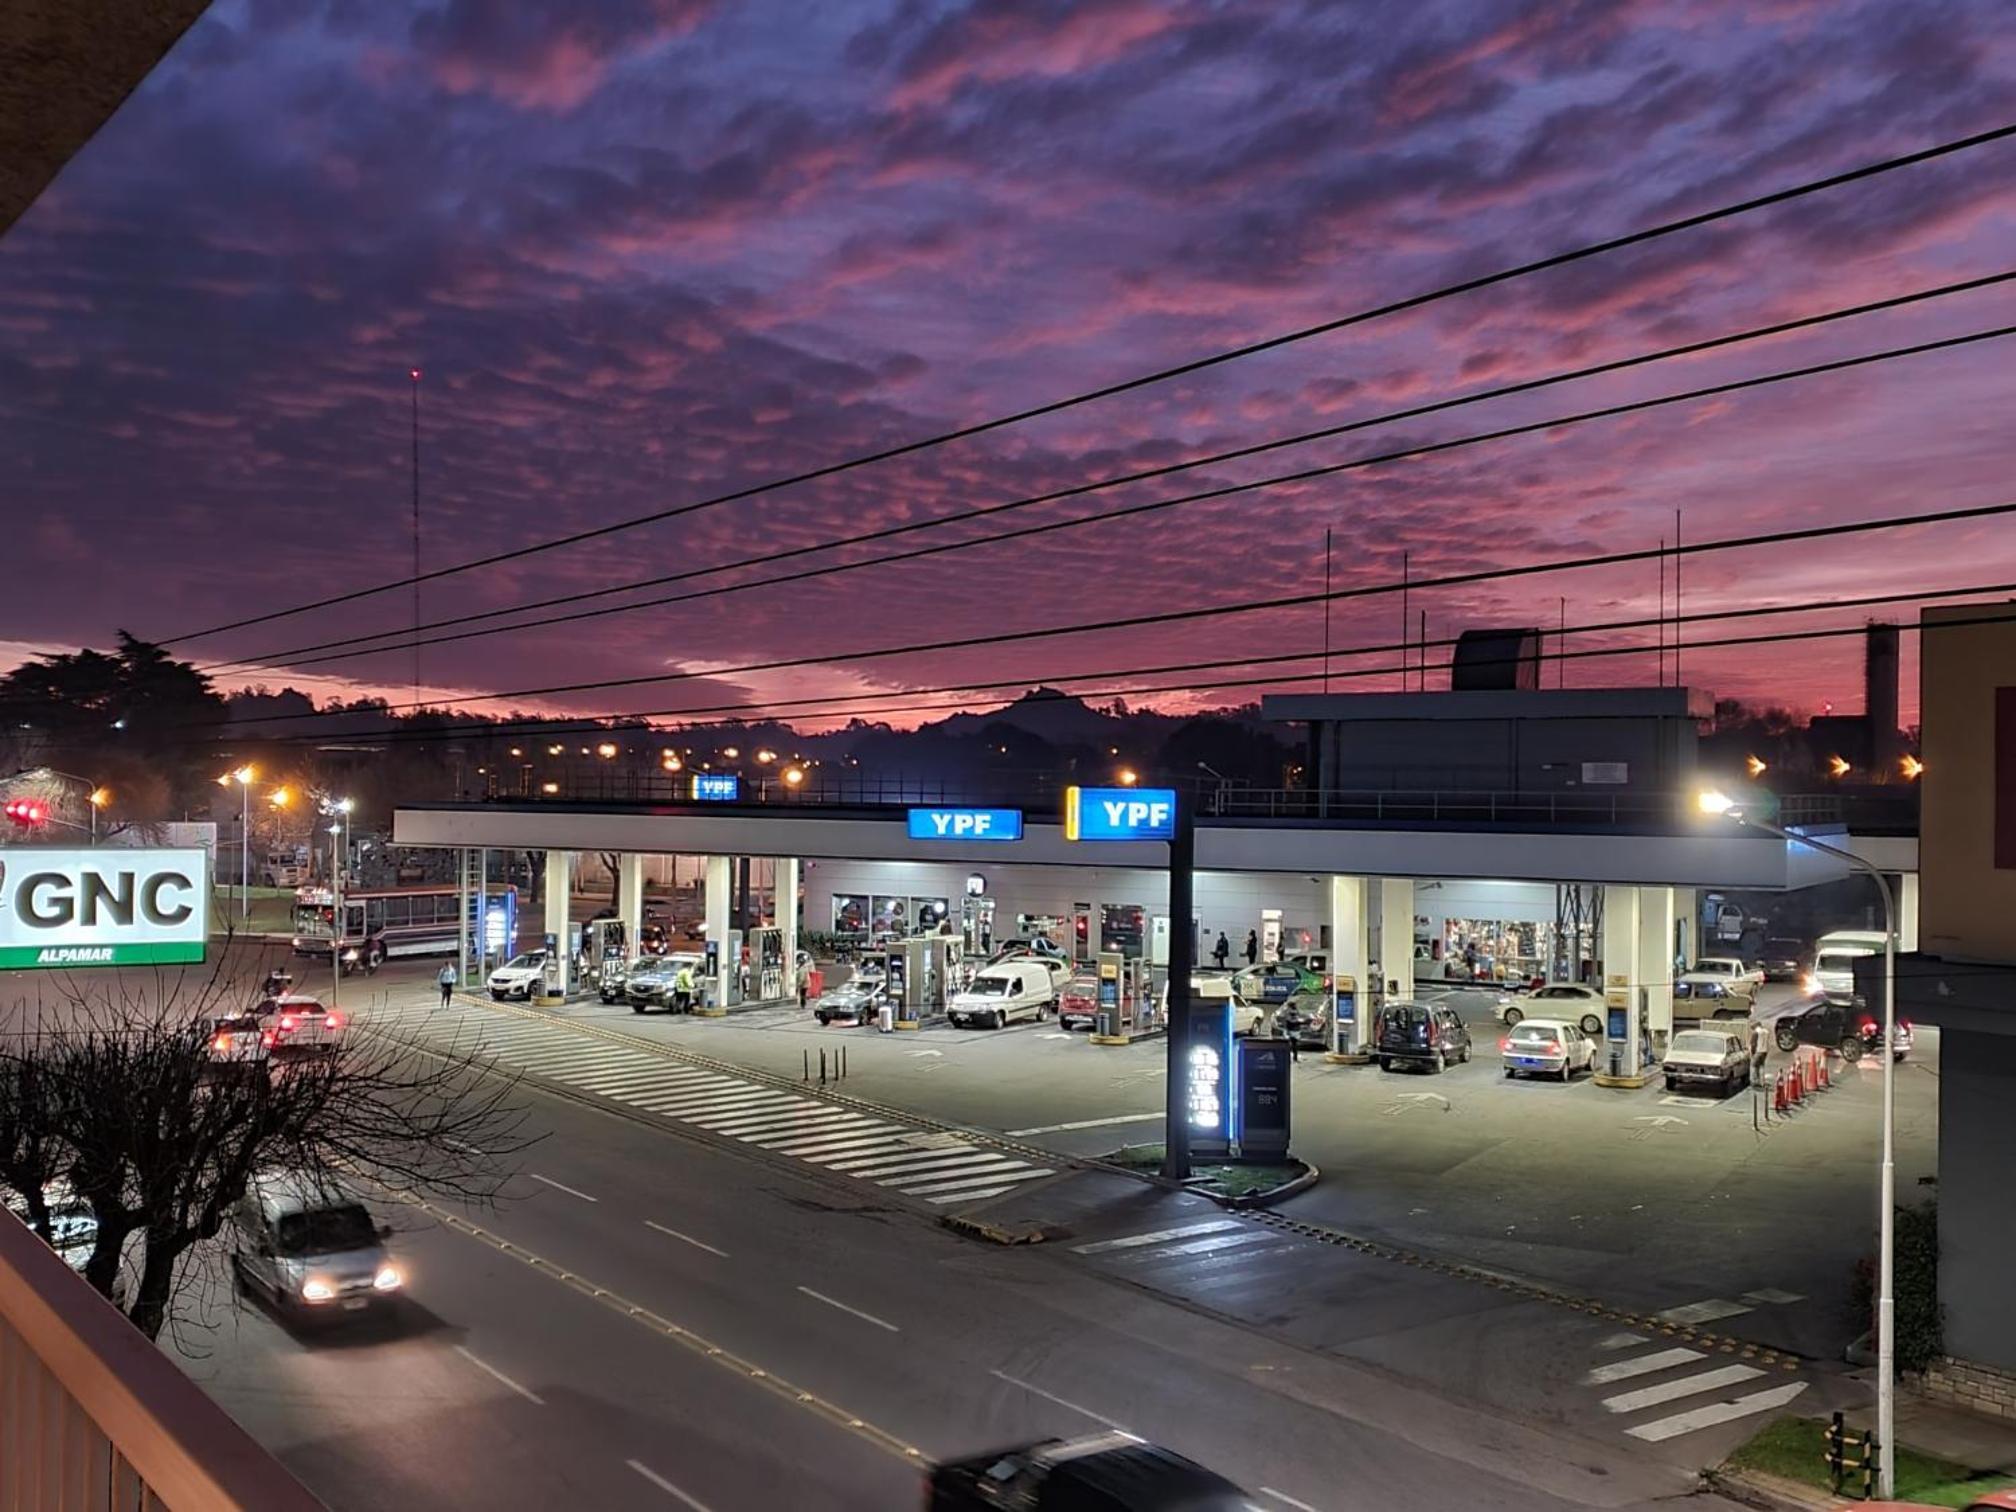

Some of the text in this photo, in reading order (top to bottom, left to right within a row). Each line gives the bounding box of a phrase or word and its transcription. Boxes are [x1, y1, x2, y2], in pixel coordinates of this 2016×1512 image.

[702, 781, 733, 794] YPF
[931, 813, 992, 836] YPF
[1103, 801, 1170, 828] YPF
[14, 871, 194, 930] GNC
[37, 947, 114, 963] ALPAMAR
